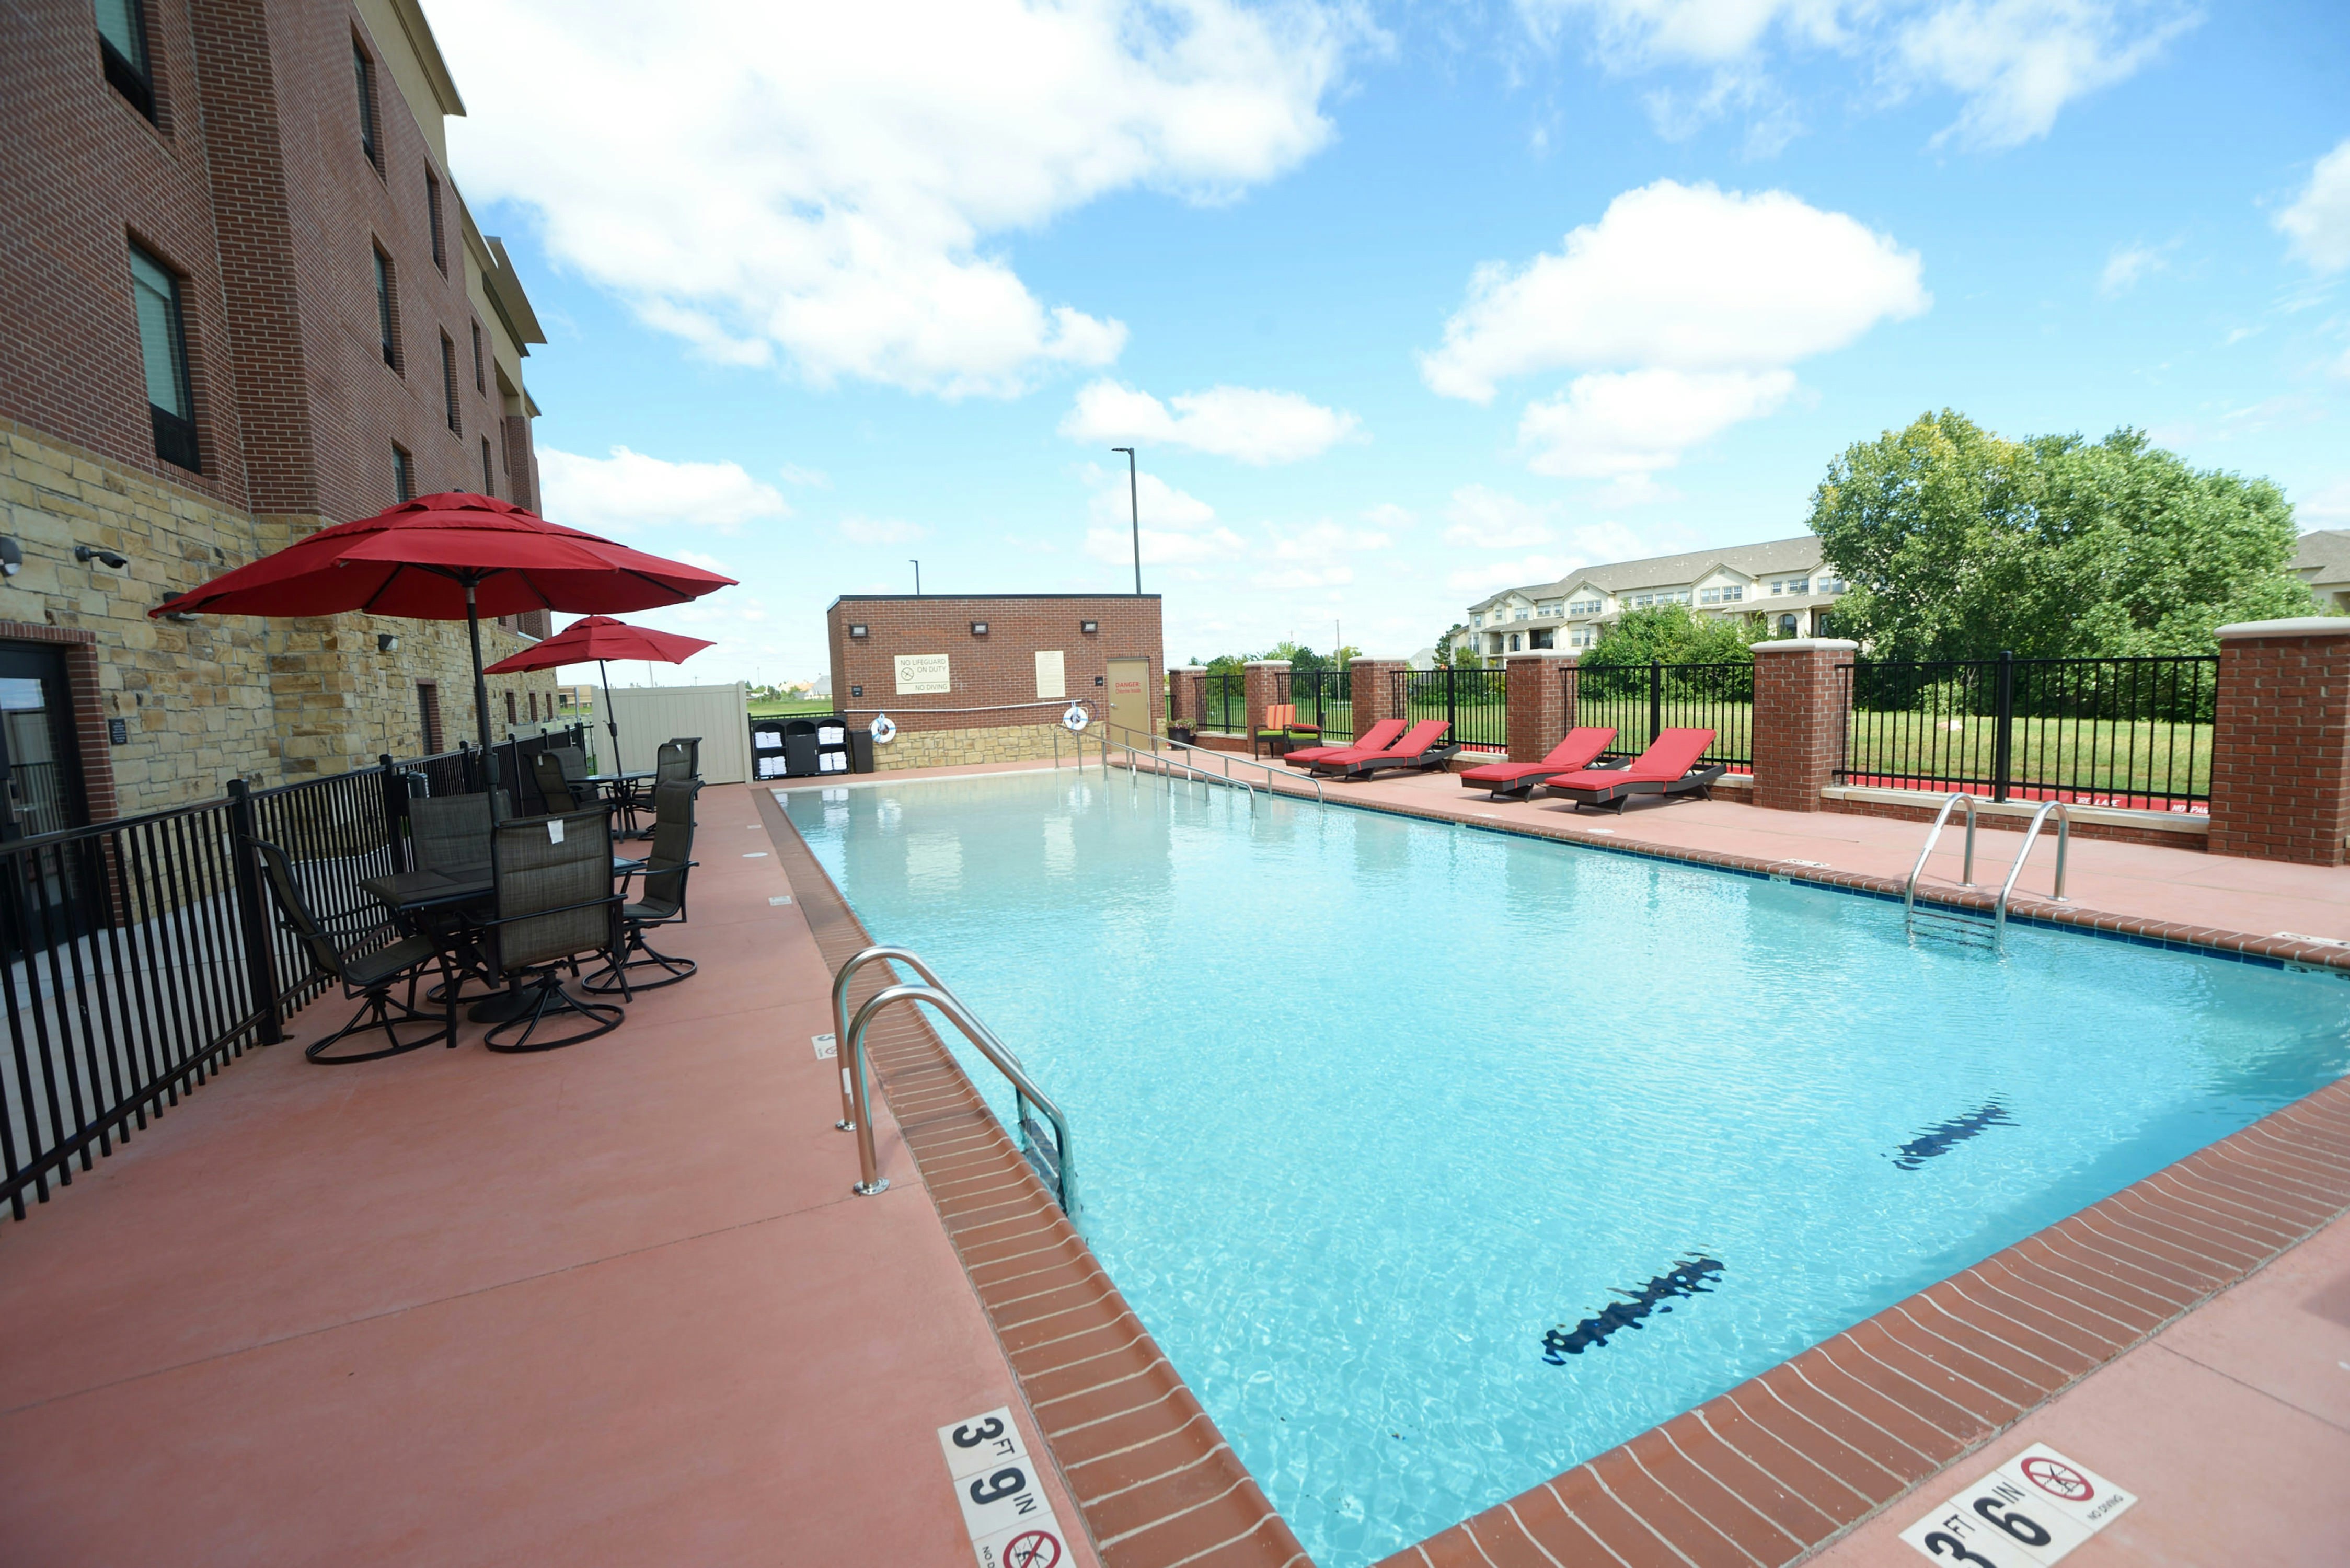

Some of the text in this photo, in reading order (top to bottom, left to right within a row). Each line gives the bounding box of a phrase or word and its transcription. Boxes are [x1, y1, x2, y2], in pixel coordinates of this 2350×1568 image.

[2075, 796, 2091, 805] IRE
[2094, 799, 2121, 807] LAE
[952, 1417, 1037, 1515] 3 FT 9 IN
[2086, 1494, 2124, 1521] NO DIVING
[1924, 1481, 2052, 1568] 3 FT 6 IN
[982, 1546, 993, 1560] NO
